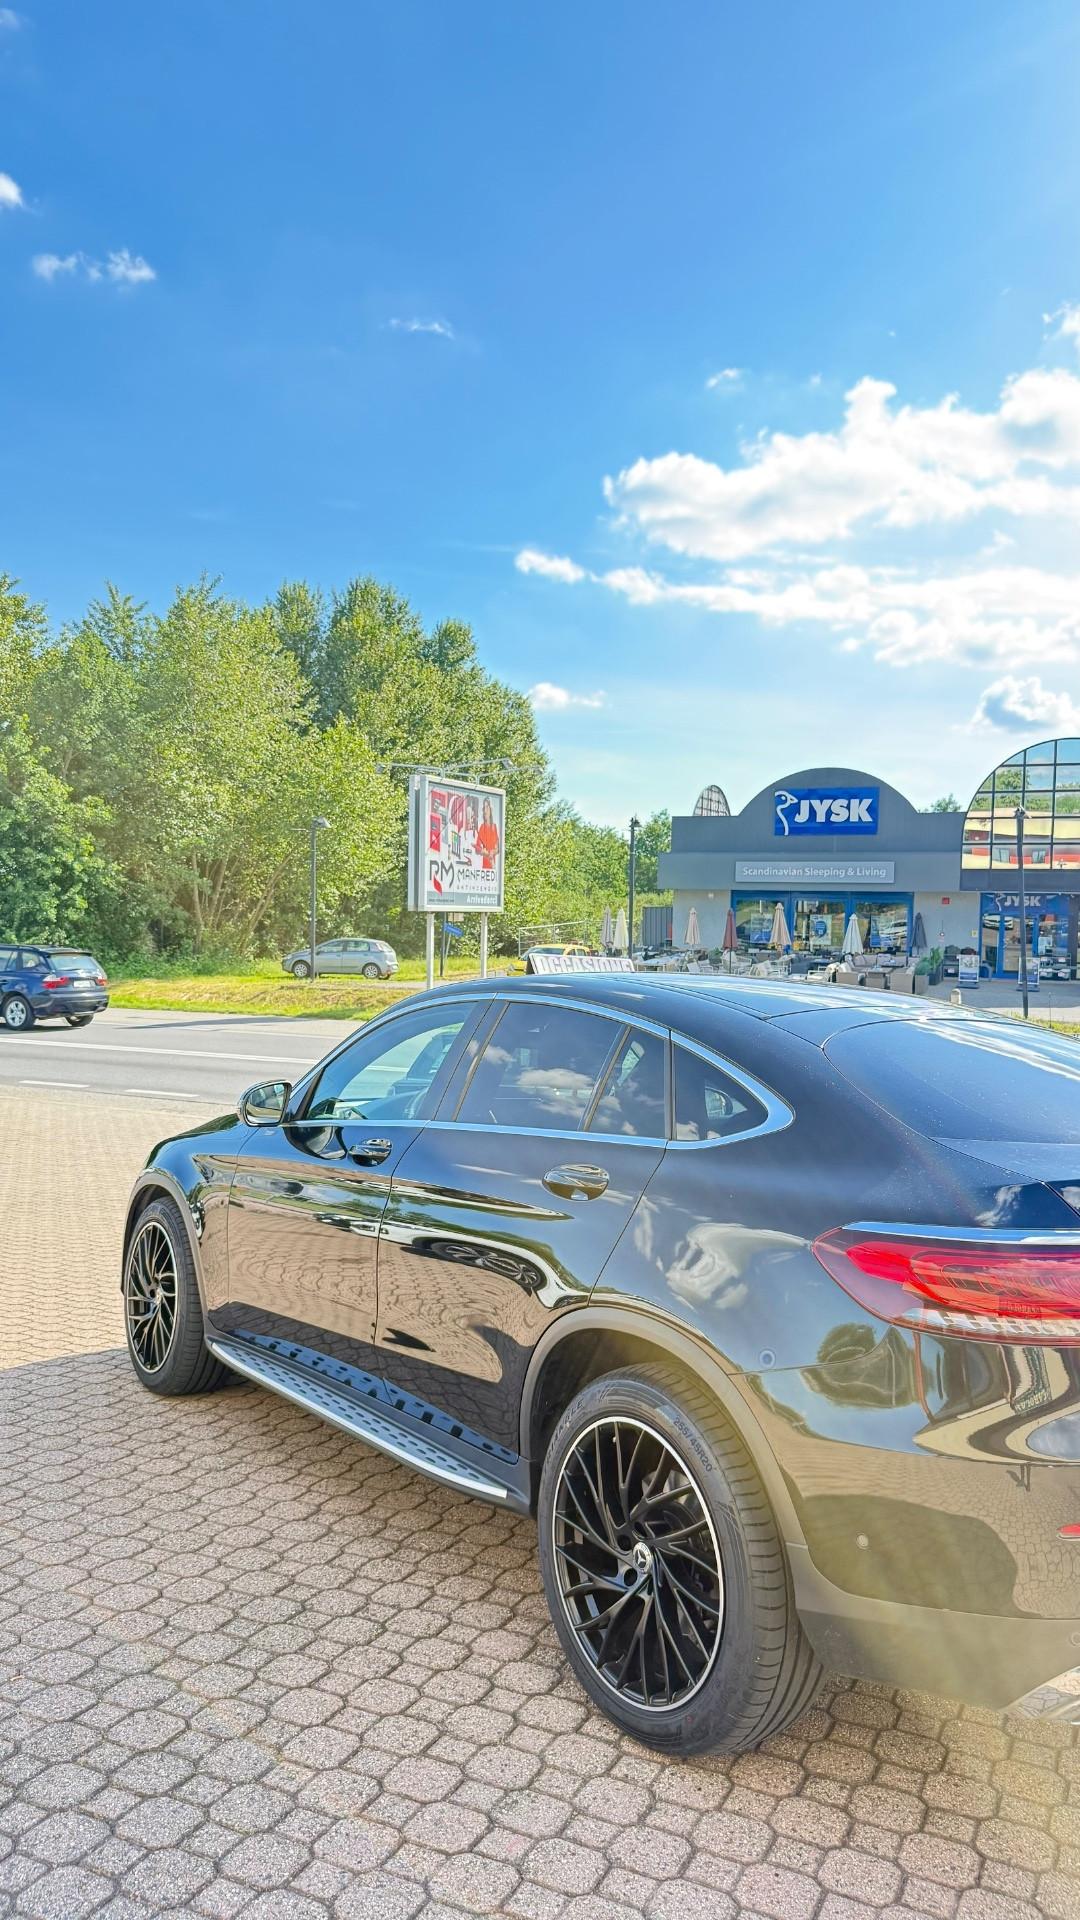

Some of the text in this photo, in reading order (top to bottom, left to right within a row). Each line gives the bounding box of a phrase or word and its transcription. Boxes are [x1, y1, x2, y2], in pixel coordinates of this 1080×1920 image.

[794, 798, 873, 823] JYSK
[457, 868, 497, 881] MANFREDI
[743, 866, 886, 878] Scandinavian Sleeping & Living
[673, 1415, 712, 1471] 255/45R20
